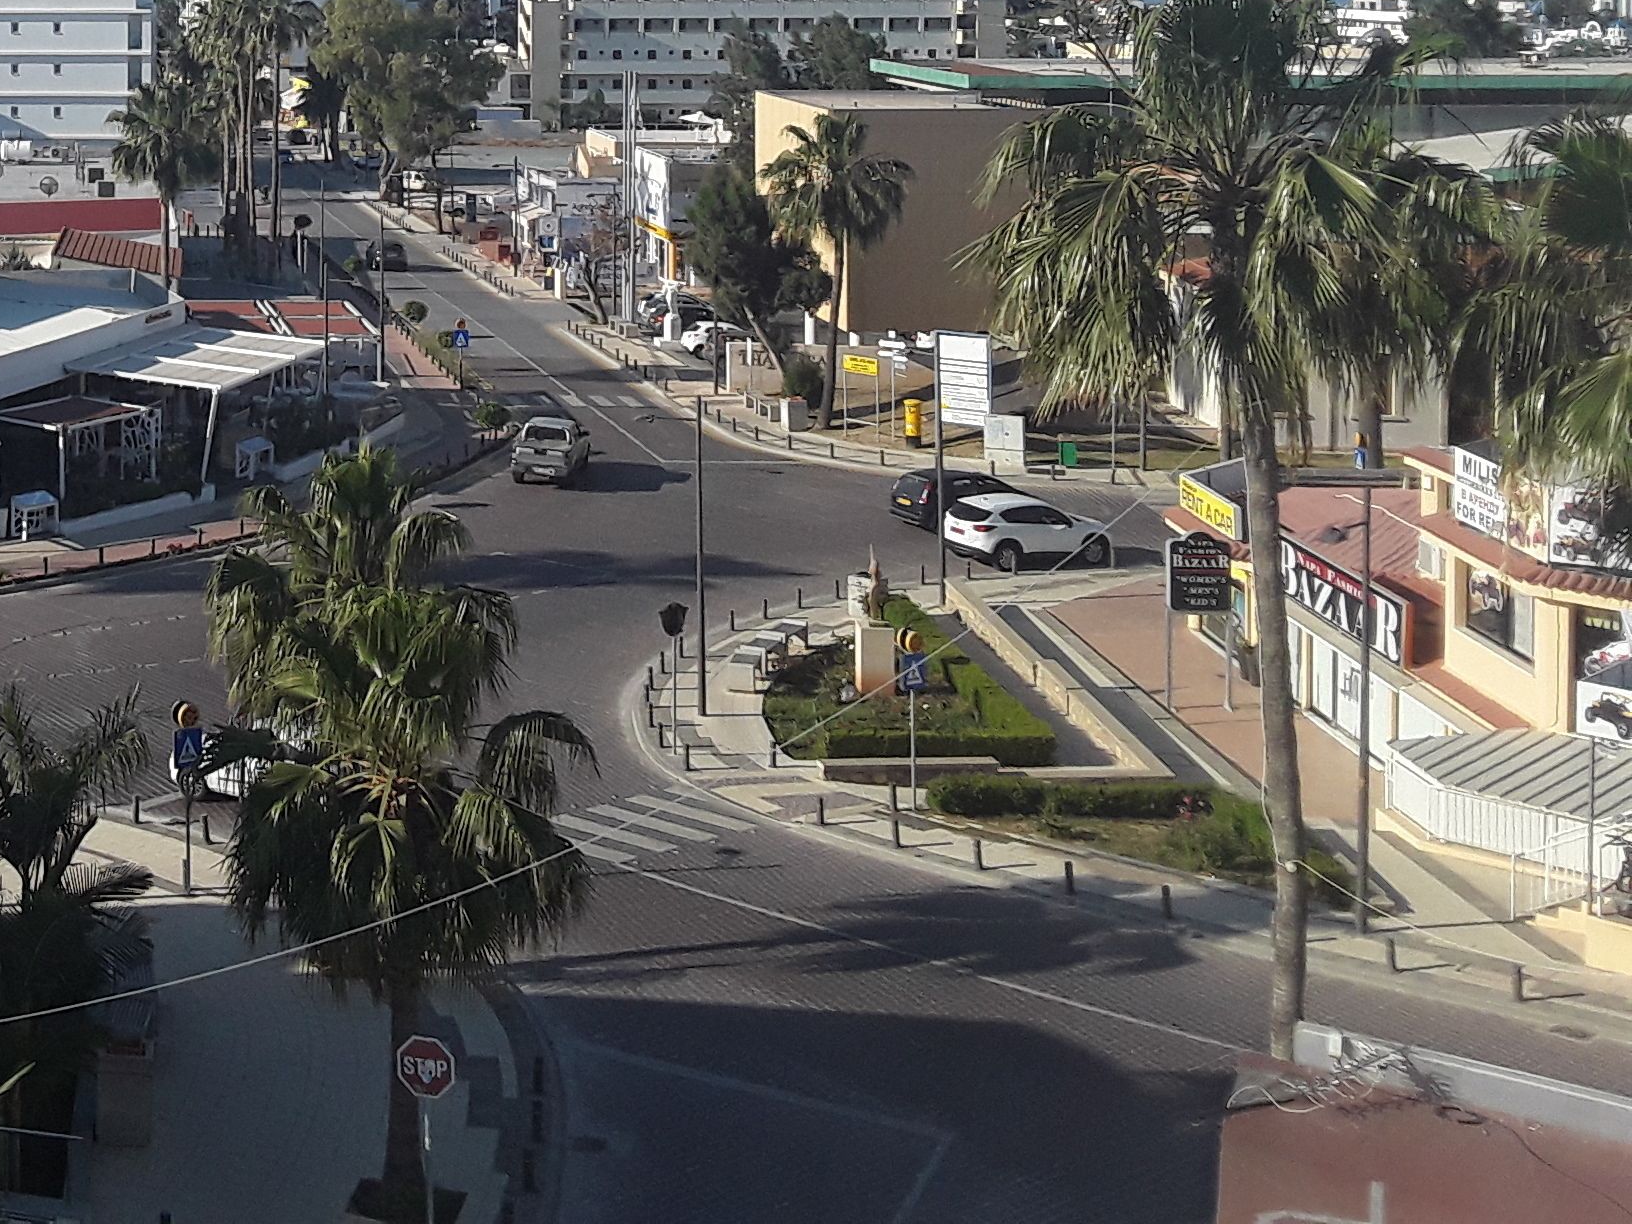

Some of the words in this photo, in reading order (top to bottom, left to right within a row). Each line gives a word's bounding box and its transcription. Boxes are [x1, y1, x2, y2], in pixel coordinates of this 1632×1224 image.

[1456, 501, 1477, 523] FOR
[1172, 553, 1230, 569] BAZAAR
[1296, 550, 1321, 576] NAPA
